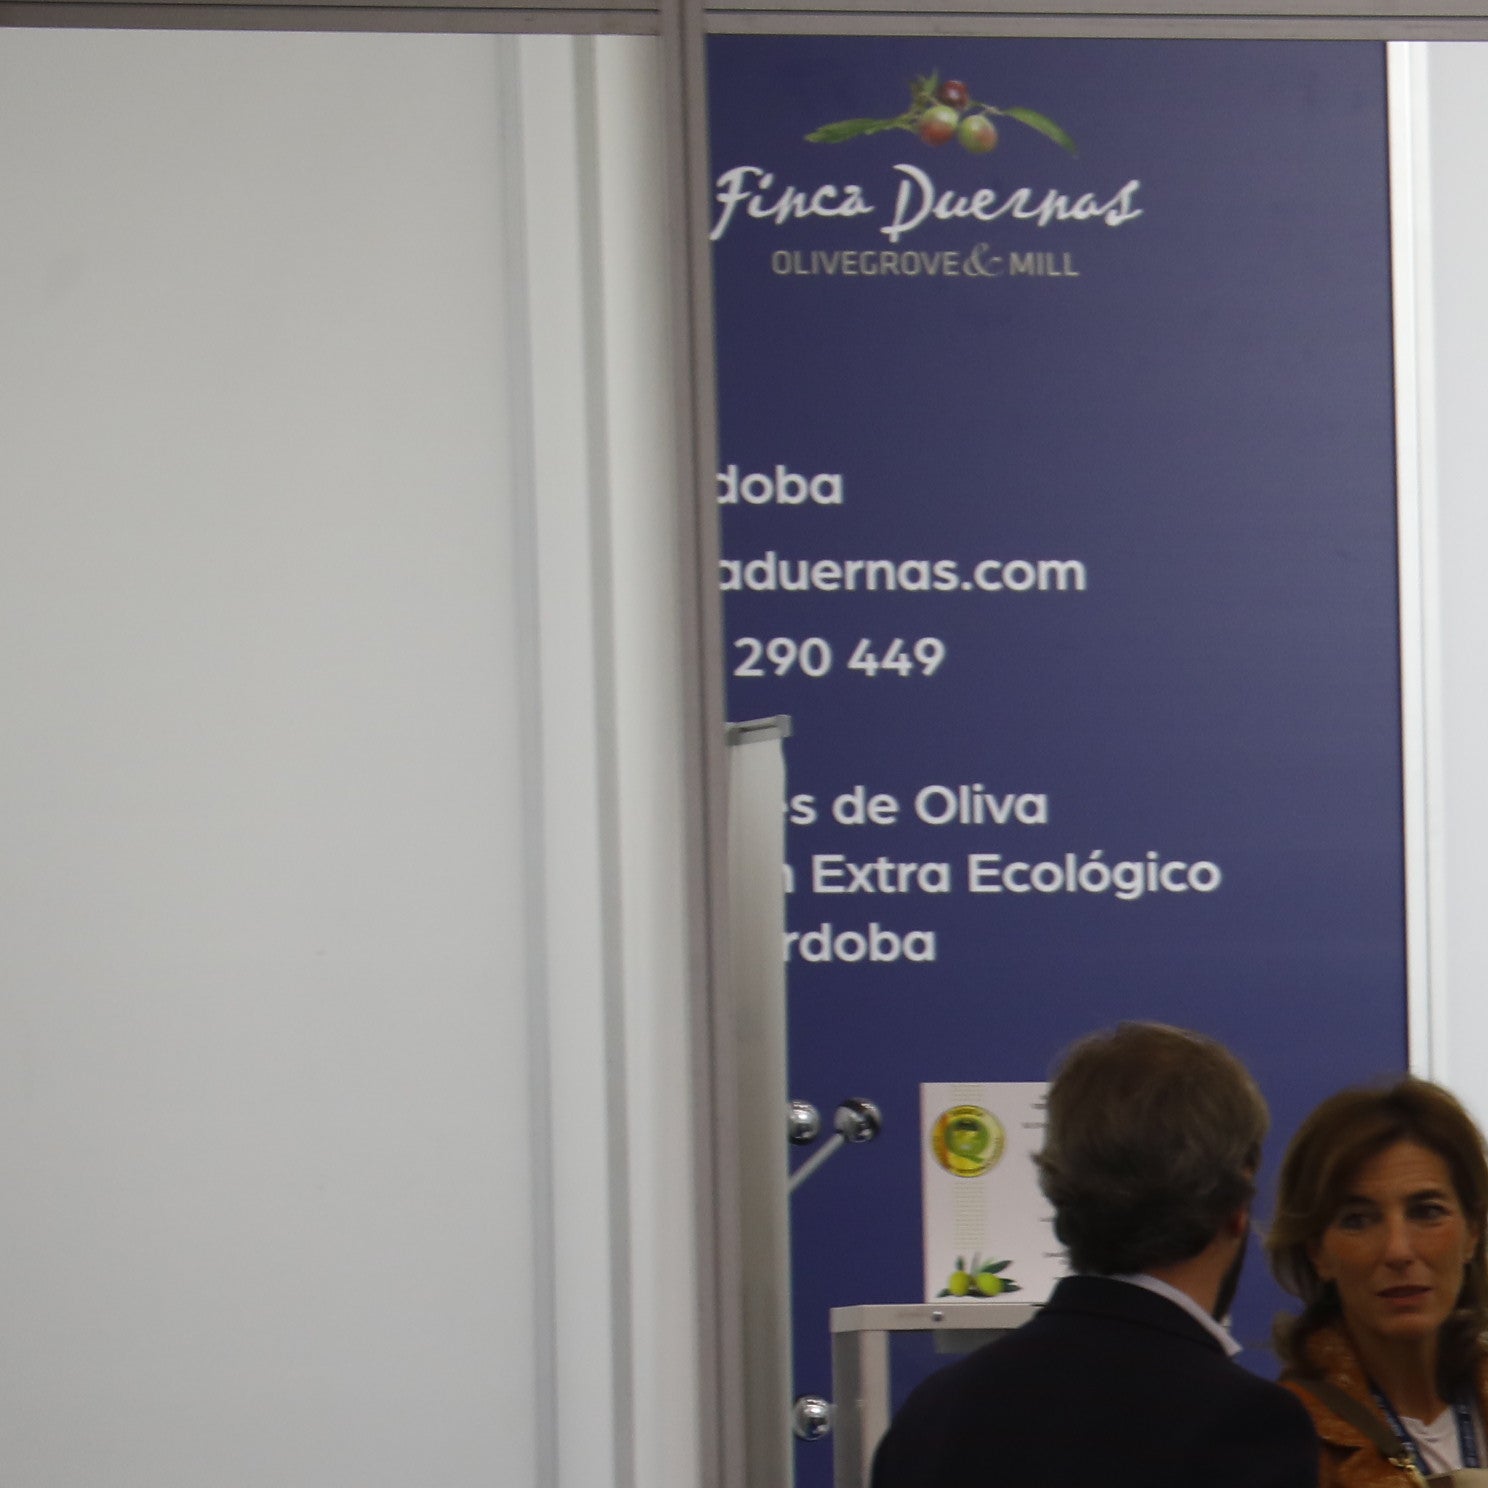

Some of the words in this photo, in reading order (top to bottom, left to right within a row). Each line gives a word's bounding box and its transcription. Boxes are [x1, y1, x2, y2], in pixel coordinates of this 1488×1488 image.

[709, 164, 874, 240] Finca
[880, 162, 1143, 243] Duernas
[1009, 251, 1080, 277] MILL
[716, 464, 842, 504] doba
[718, 551, 1087, 592] aduernas.com
[733, 637, 831, 676] 290
[847, 637, 946, 676] 449
[832, 786, 899, 825] de
[915, 783, 1048, 825] Oliva
[812, 853, 950, 893] Extra
[968, 850, 1222, 900] Ecológico
[782, 922, 937, 963] rdoba
